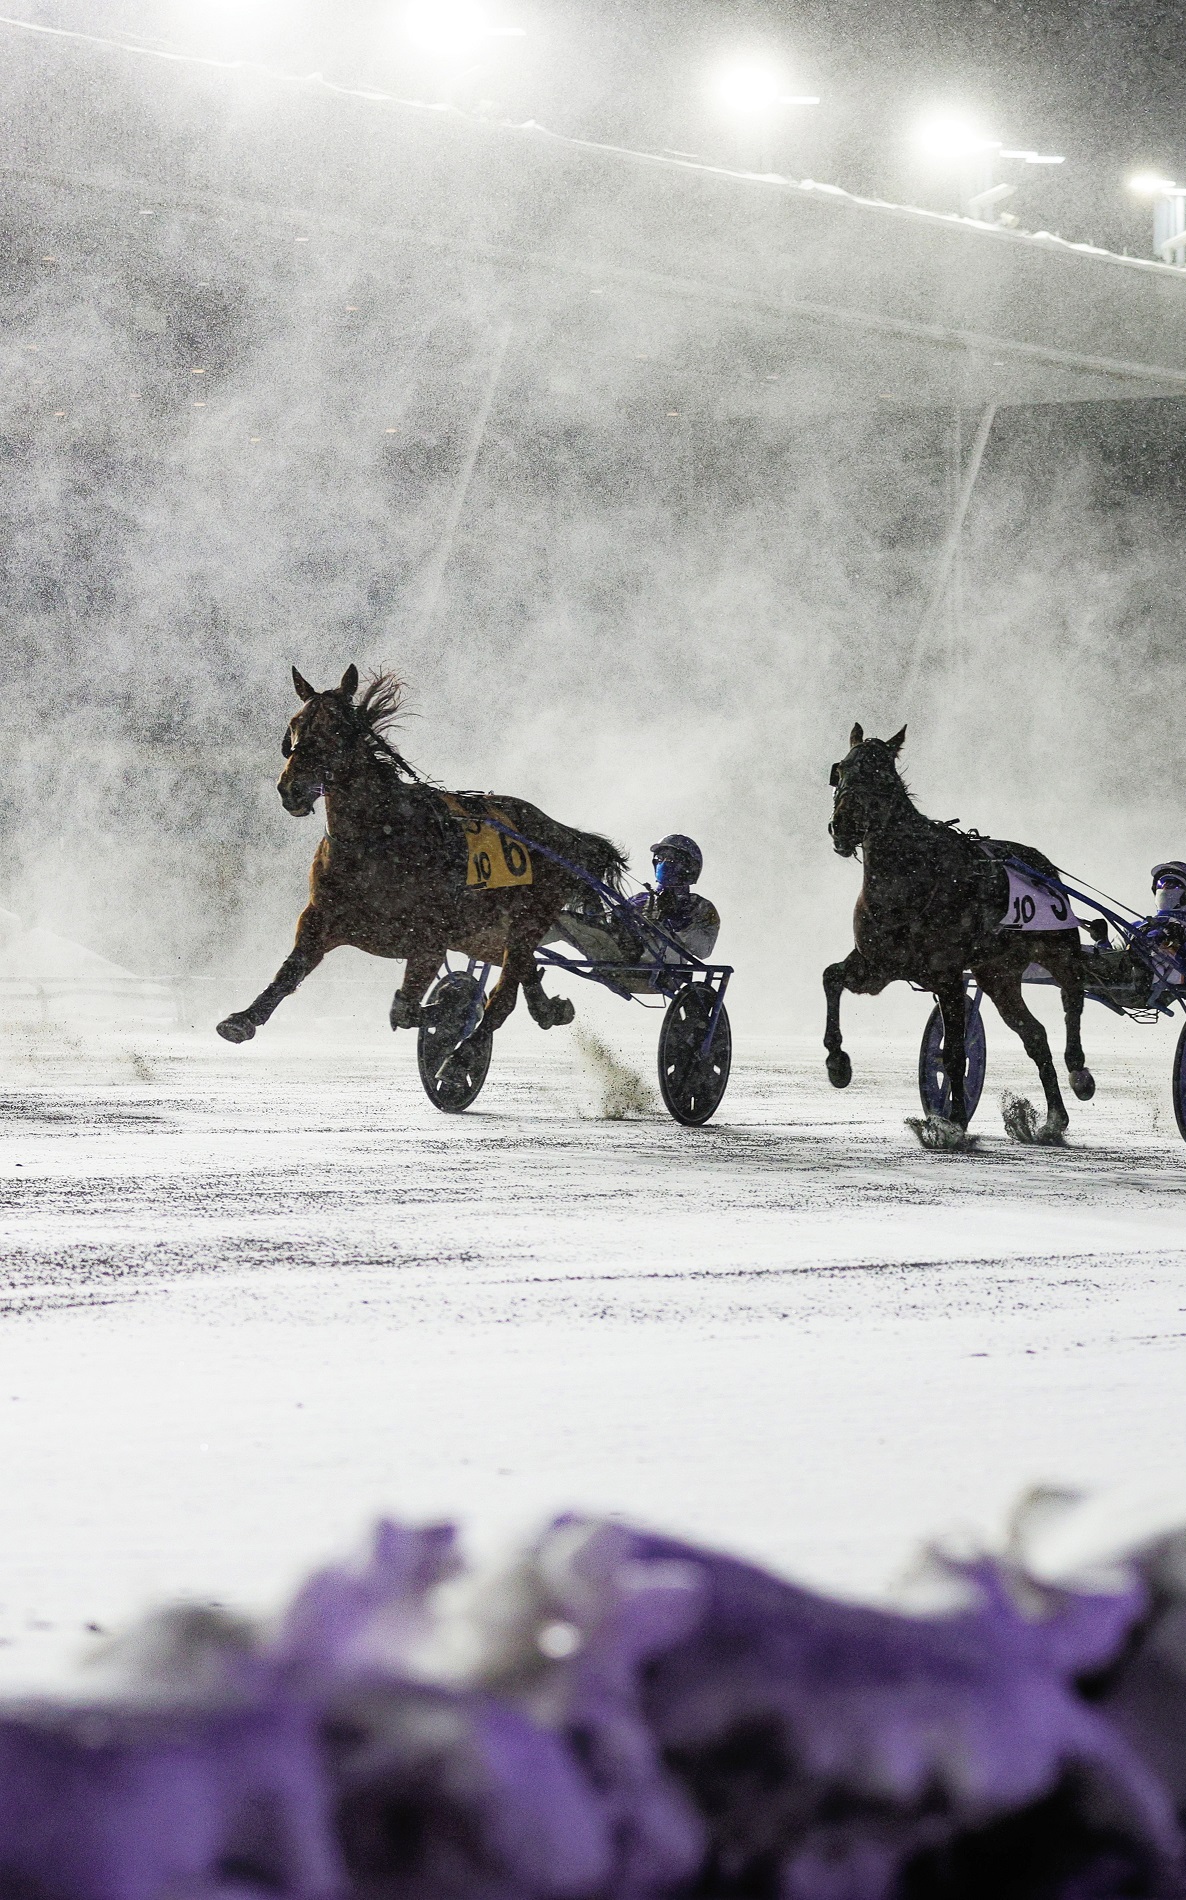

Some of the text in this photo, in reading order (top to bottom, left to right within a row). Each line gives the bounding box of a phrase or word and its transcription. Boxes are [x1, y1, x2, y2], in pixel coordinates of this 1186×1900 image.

[473, 851, 492, 882] 10
[499, 831, 527, 878] 6
[1013, 894, 1035, 924] 10
